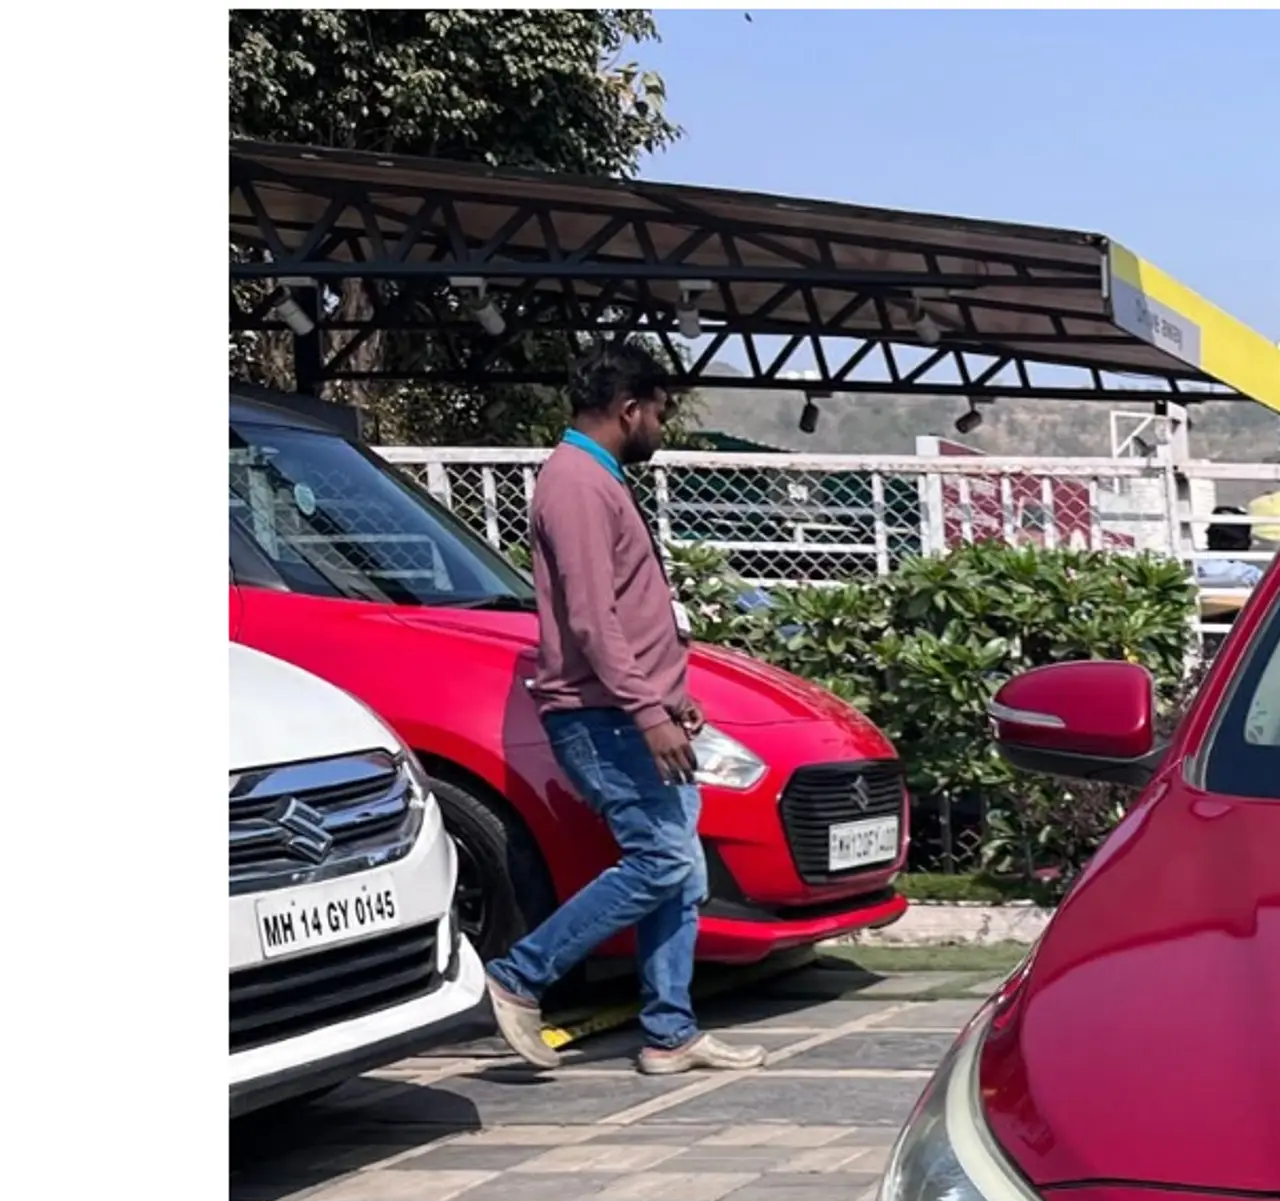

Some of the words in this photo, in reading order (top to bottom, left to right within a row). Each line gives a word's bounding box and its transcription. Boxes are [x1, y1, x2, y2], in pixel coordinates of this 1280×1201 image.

[263, 911, 296, 947] MH
[300, 906, 323, 938] 14
[326, 899, 349, 932] GY
[355, 890, 396, 925] 0145
